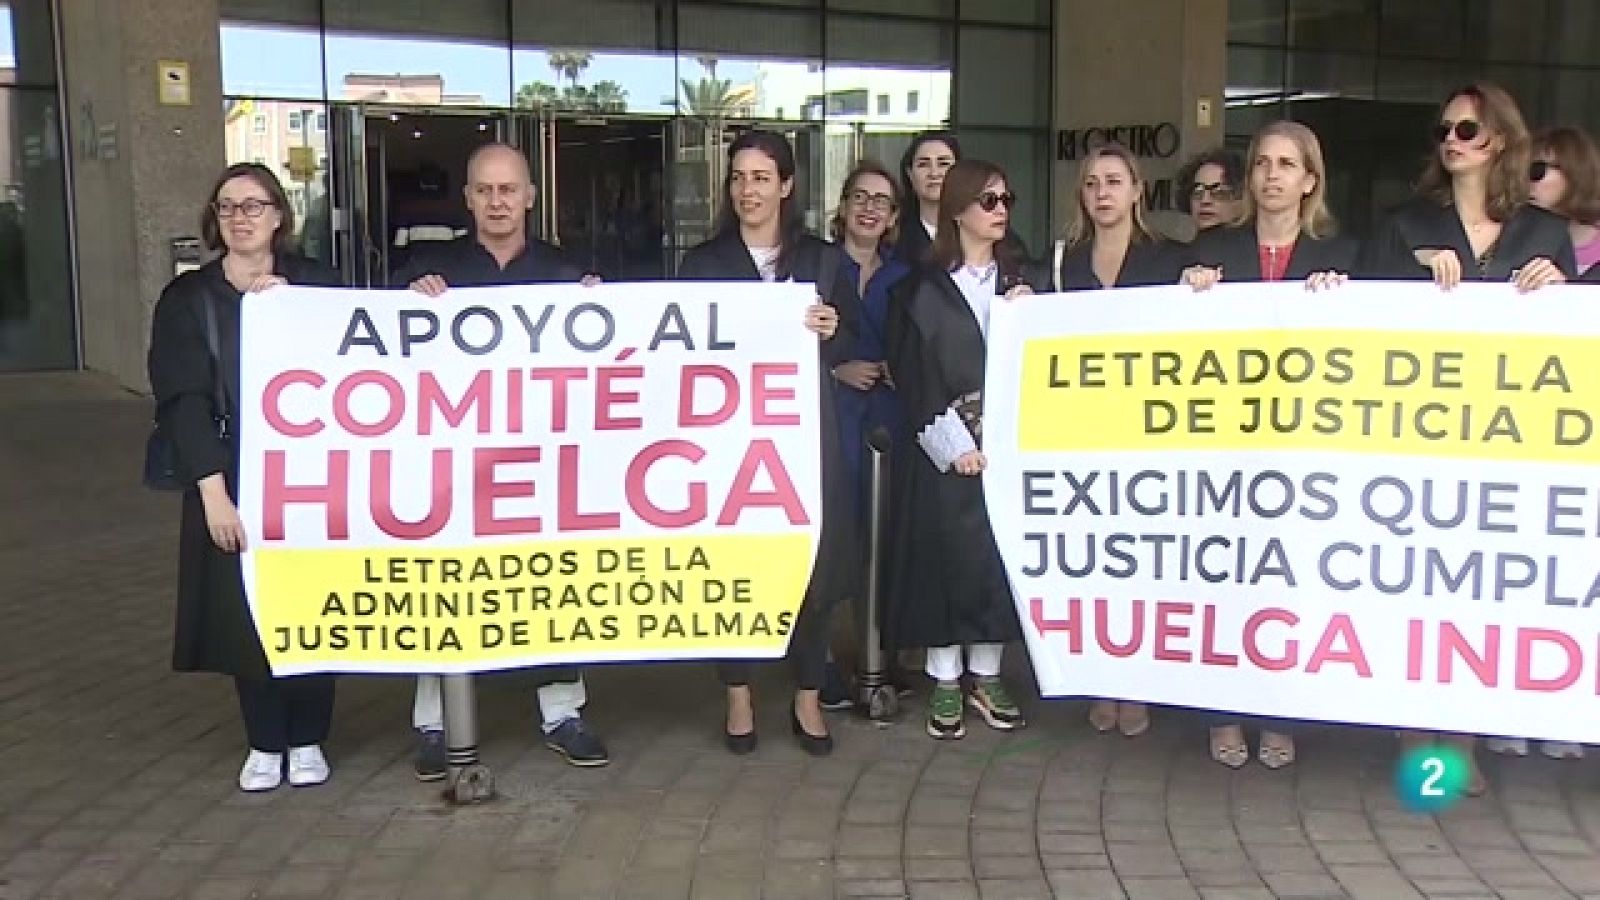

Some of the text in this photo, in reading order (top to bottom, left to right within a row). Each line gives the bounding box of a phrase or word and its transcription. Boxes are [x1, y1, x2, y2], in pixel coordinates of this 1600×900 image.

[337, 302, 736, 357] APOYO AL
[261, 347, 801, 438] COMITÉ DE
[1049, 347, 1571, 392] LETRADOS DE LA
[1144, 399, 1216, 434] DE
[1240, 397, 1523, 444] JUSTICIA
[261, 439, 811, 540] HUELGA
[1022, 470, 1600, 537] EXIGIMOS QUE E
[364, 546, 711, 584] LETRADOS DE LA
[1021, 532, 1297, 588] JUSTICIA
[319, 574, 751, 618] ADMINISTRACIÓN DE
[274, 611, 793, 653] JUSTICIA DE LAS PALMAS
[1029, 597, 1600, 696] HUELGA IND
